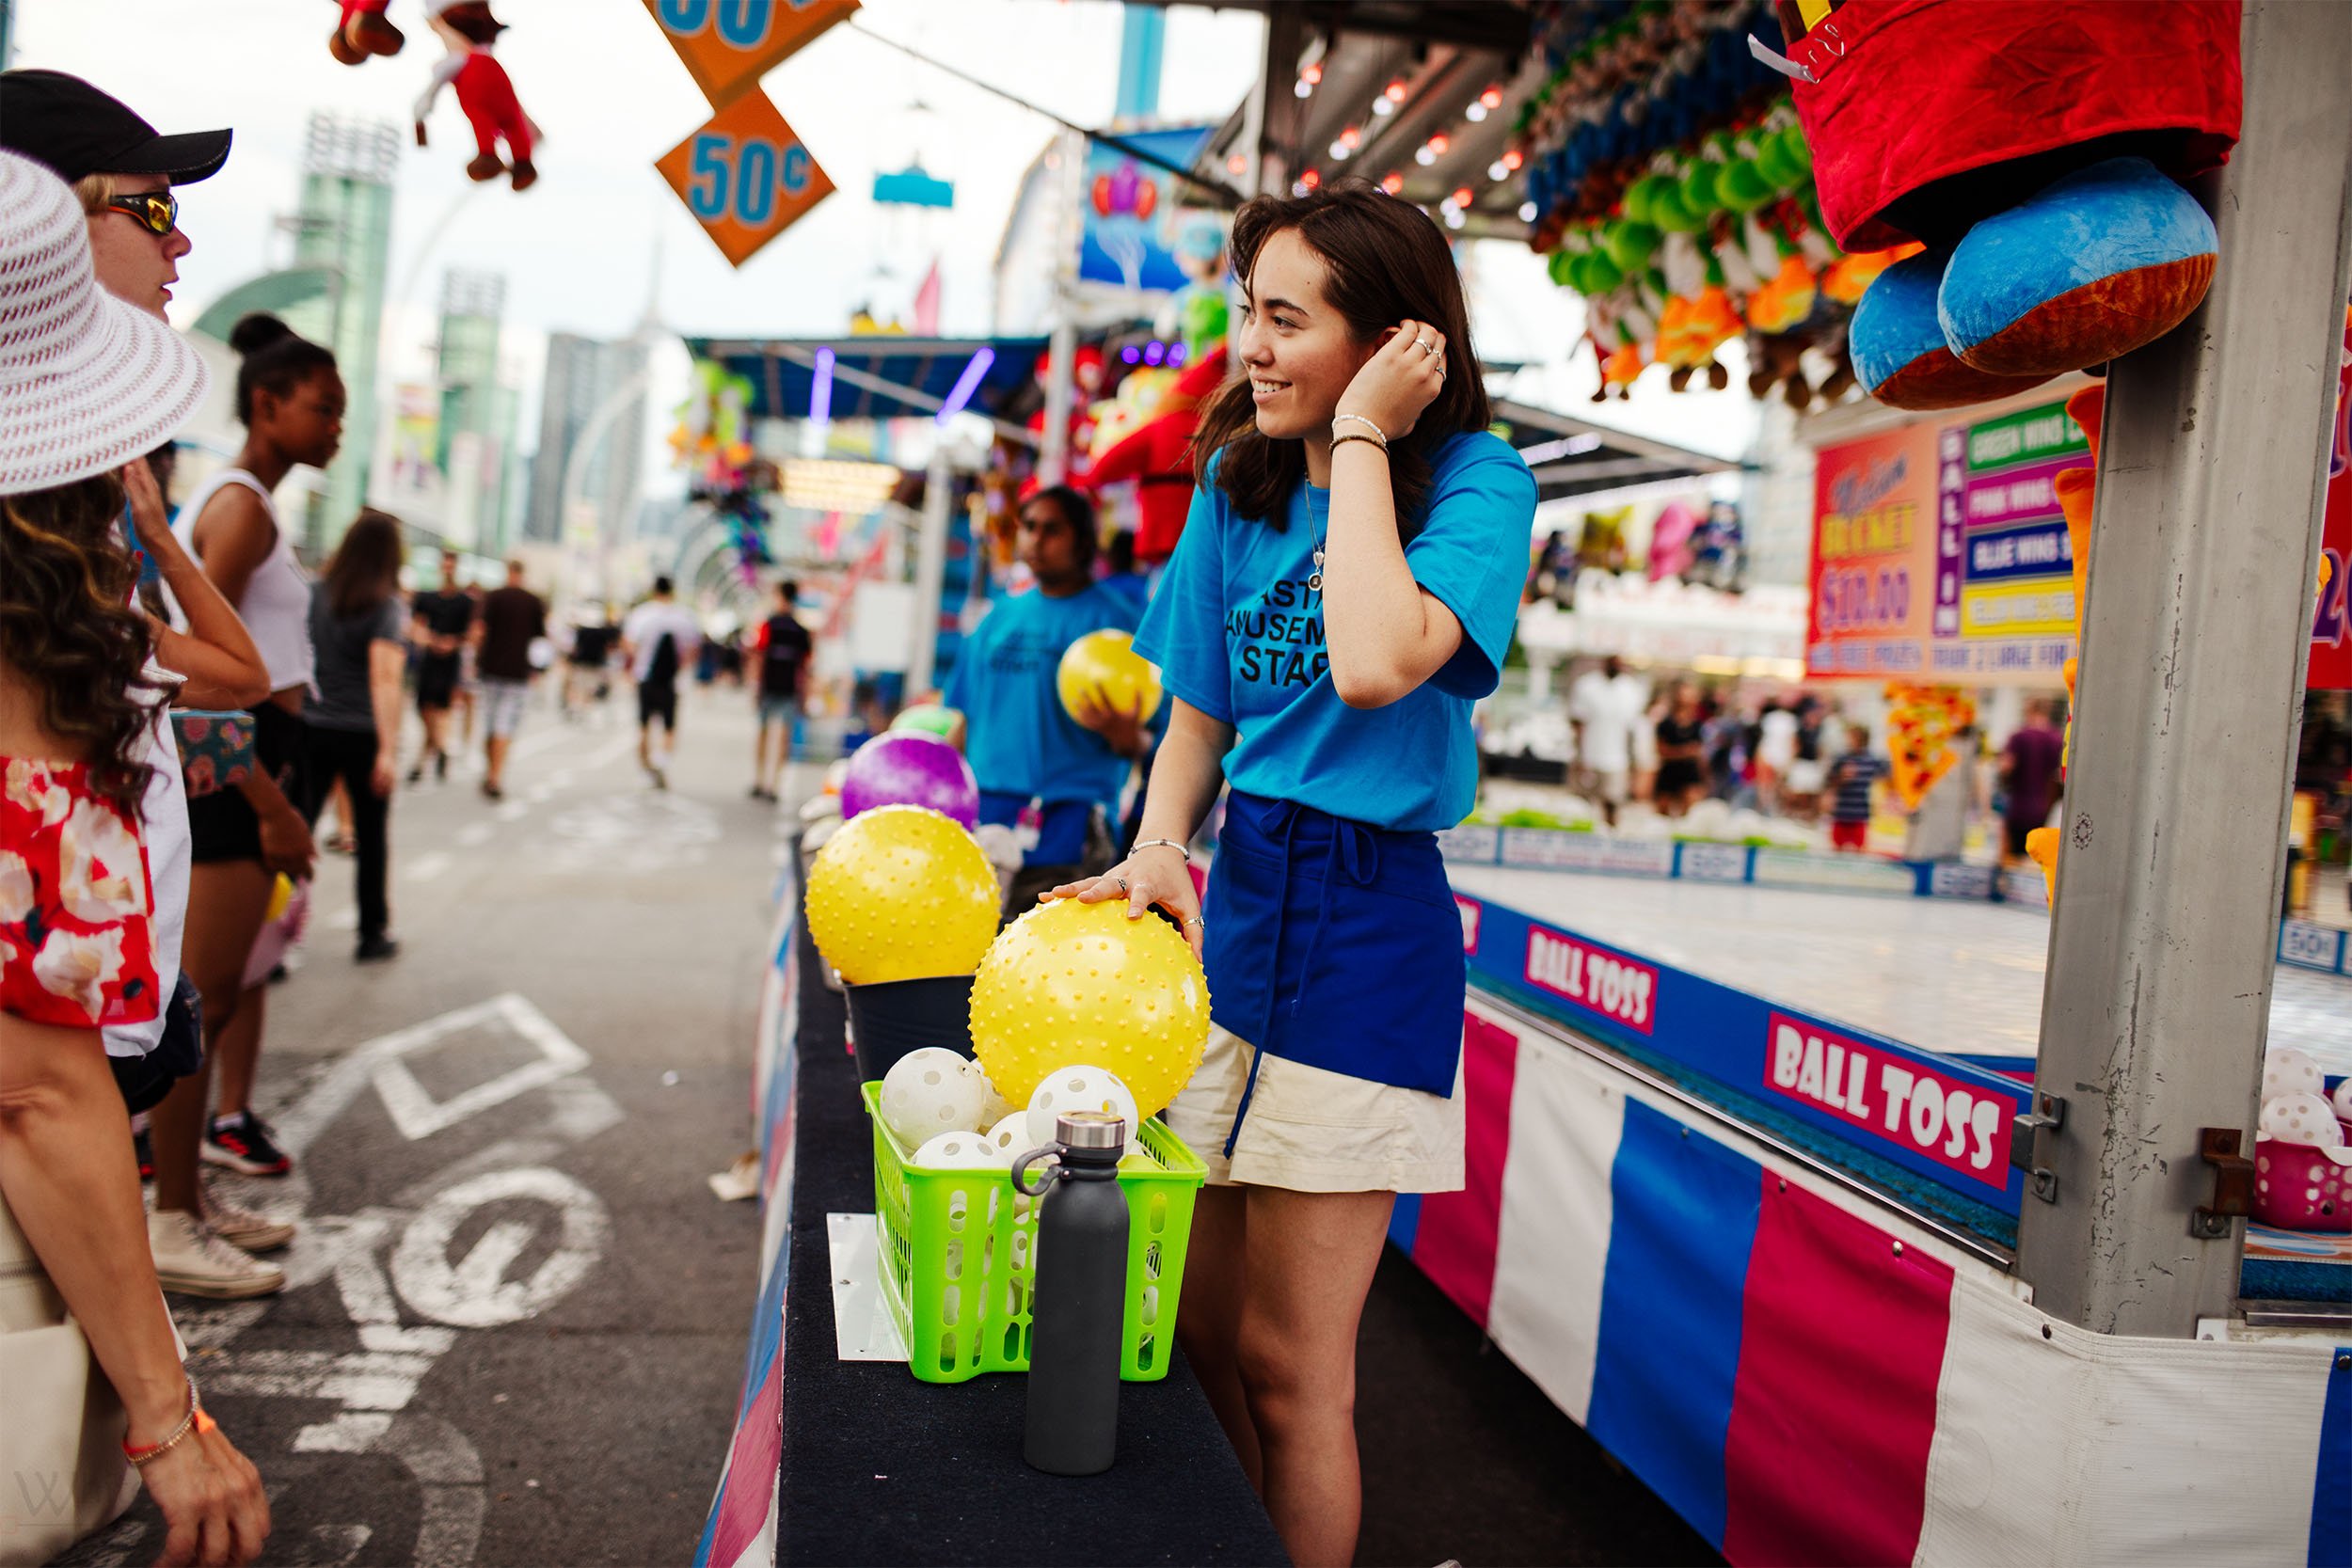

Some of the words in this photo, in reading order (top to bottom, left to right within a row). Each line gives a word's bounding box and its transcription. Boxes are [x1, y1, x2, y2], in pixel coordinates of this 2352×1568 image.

[1528, 931, 1583, 997] BALL
[1587, 954, 1651, 1023] TOSS
[1773, 1024, 1870, 1120] BALL
[1881, 1063, 2000, 1170] TOSS
